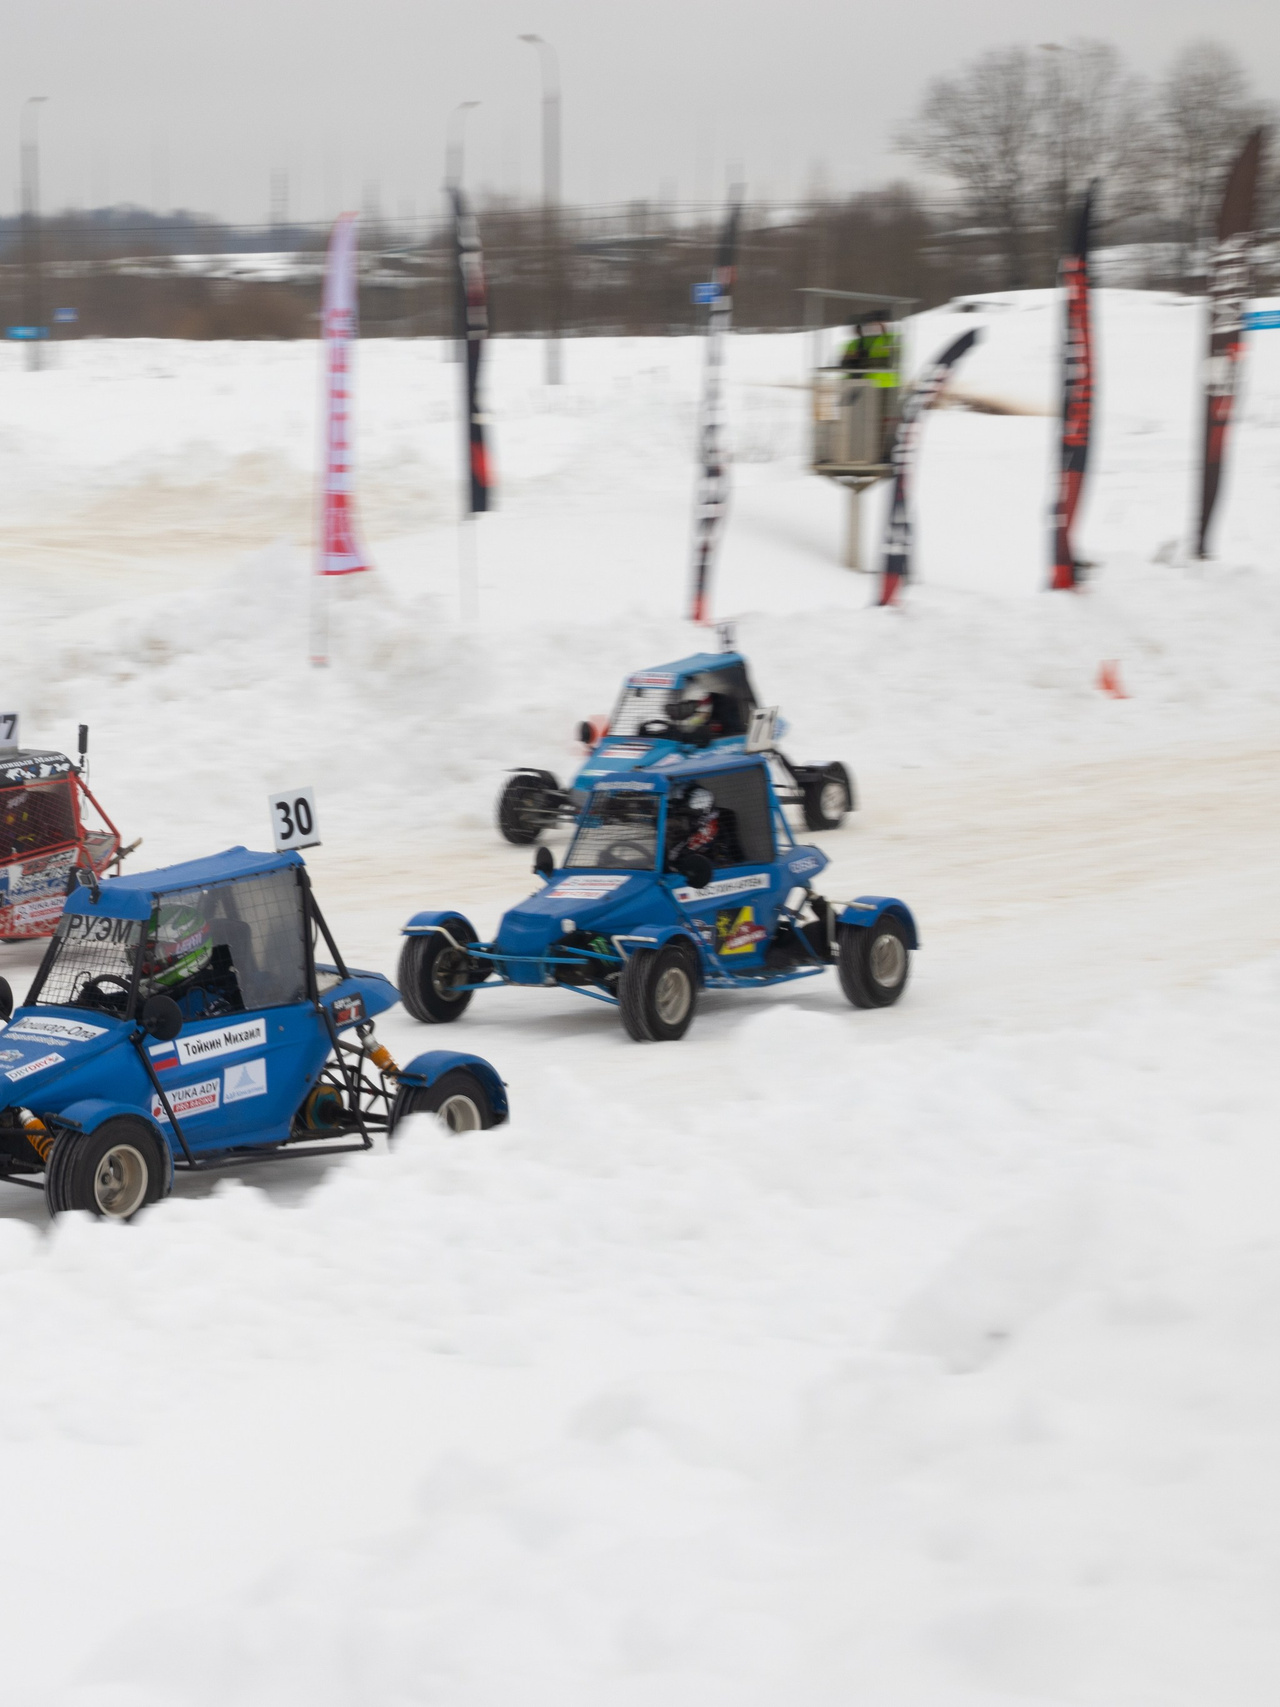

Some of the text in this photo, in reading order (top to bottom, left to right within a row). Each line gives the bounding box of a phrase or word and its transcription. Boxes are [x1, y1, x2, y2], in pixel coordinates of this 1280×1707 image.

[275, 797, 313, 840] 30
[66, 913, 134, 944] РУЭМ
[183, 1027, 261, 1057] Тойкин Михаил
[171, 1087, 198, 1102] YUKA
[199, 1081, 218, 1094] ADV
